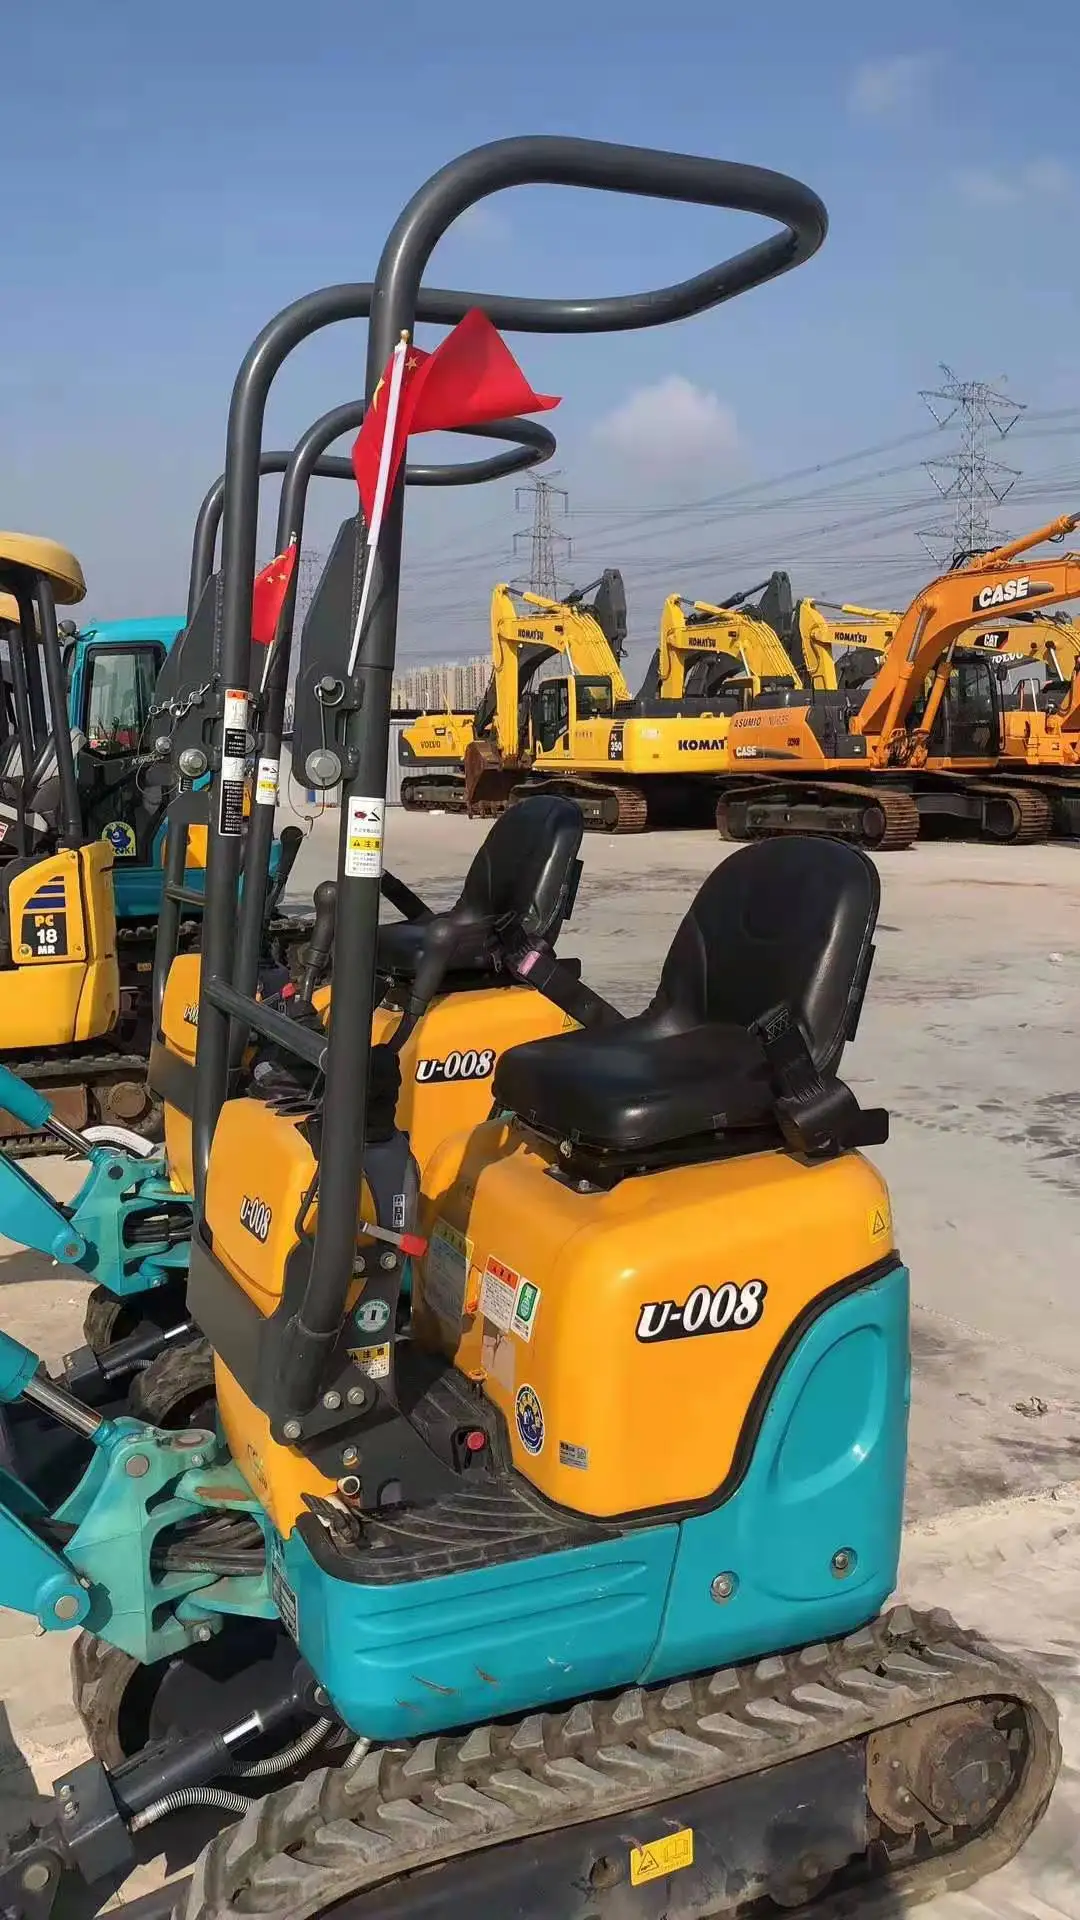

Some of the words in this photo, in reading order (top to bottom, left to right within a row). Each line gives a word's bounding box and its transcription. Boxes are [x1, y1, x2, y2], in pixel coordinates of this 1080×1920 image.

[978, 575, 1031, 608] CASE
[688, 636, 716, 648] KOMATSU
[834, 631, 868, 643] KOMATSU
[983, 632, 999, 648] CAT
[678, 736, 728, 751] KOMAT
[735, 746, 757, 757] CASE
[34, 914, 55, 928] PC
[36, 928, 58, 945] 18
[37, 944, 56, 955] MR
[416, 1050, 494, 1081] U-008
[240, 1196, 272, 1240] U-008
[637, 1280, 763, 1338] U-008
